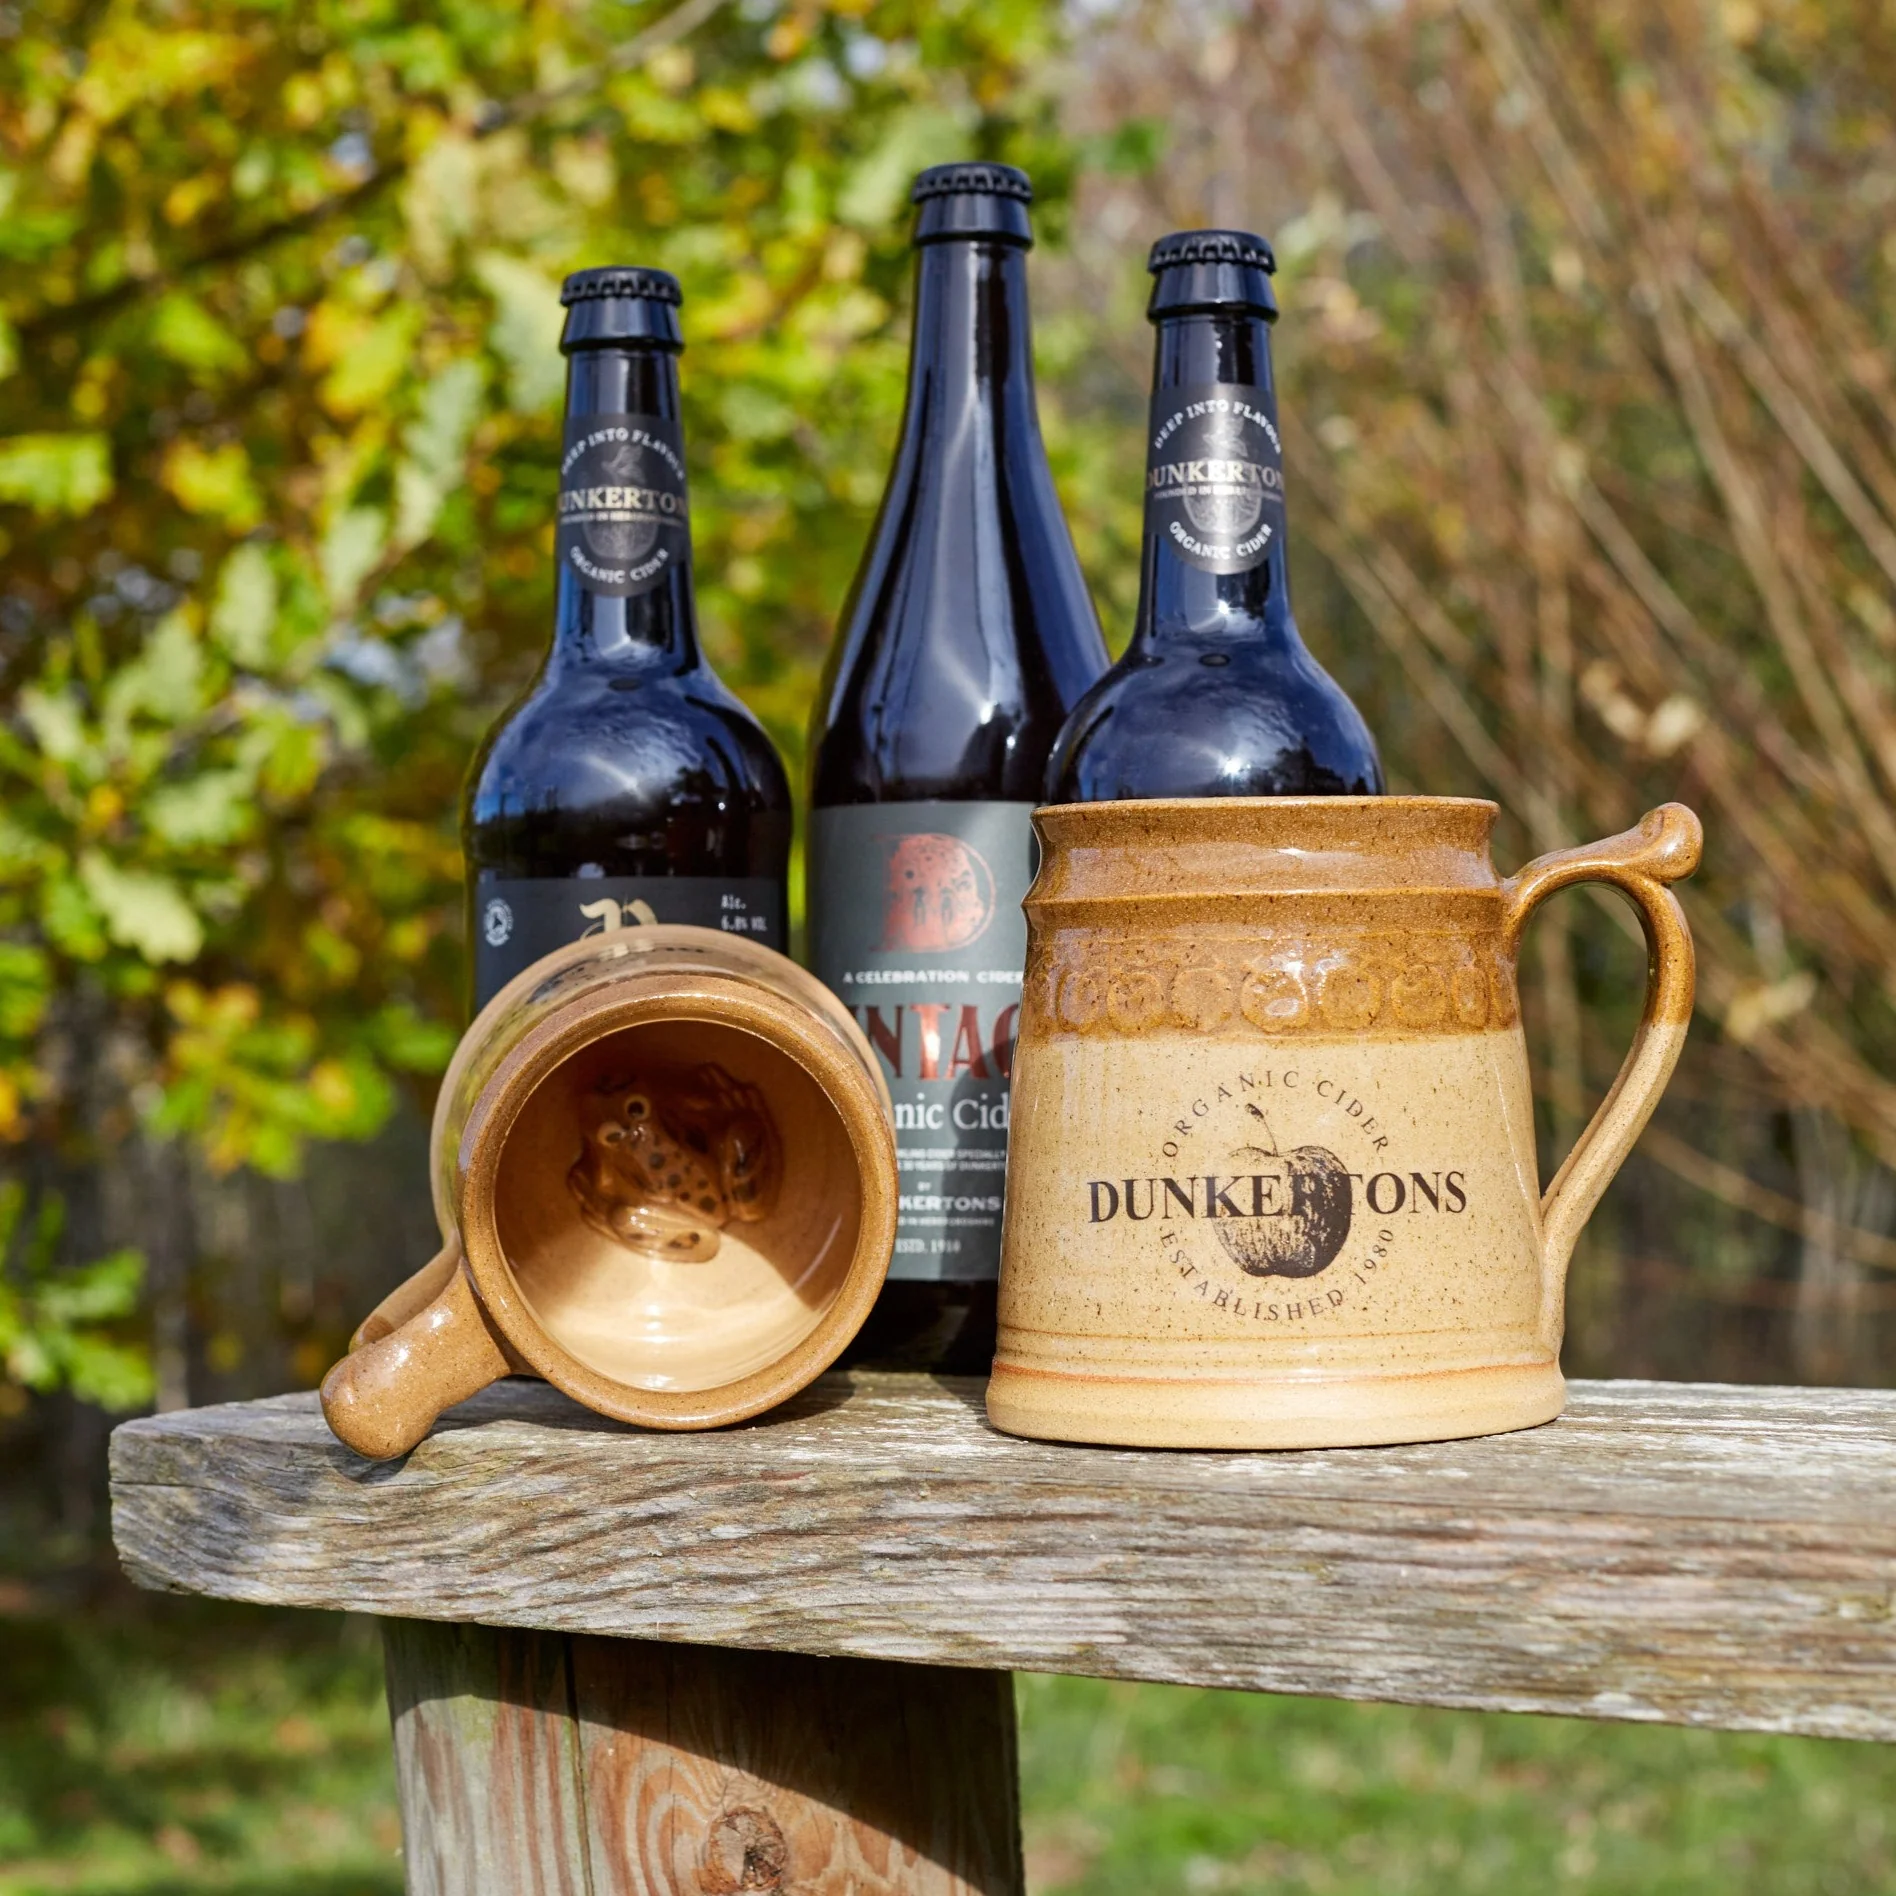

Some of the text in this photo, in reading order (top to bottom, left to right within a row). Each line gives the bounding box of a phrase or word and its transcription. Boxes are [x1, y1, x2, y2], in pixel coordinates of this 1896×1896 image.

[1186, 399, 1229, 419] INTO
[588, 427, 629, 447] INTO
[1169, 521, 1272, 560] ORGANIC CIDER
[570, 545, 626, 584] ORGANIC
[843, 972, 854, 984] A
[855, 970, 970, 984] CELEBRATION
[952, 1091, 1009, 1130] Cid
[1162, 1070, 1389, 1158] ORGANIC CIDER
[899, 1195, 1001, 1212] KERTONS
[1086, 1170, 1467, 1223] DUNKERTONS
[1160, 1228, 1394, 1321] ESTABLISHED 1980
